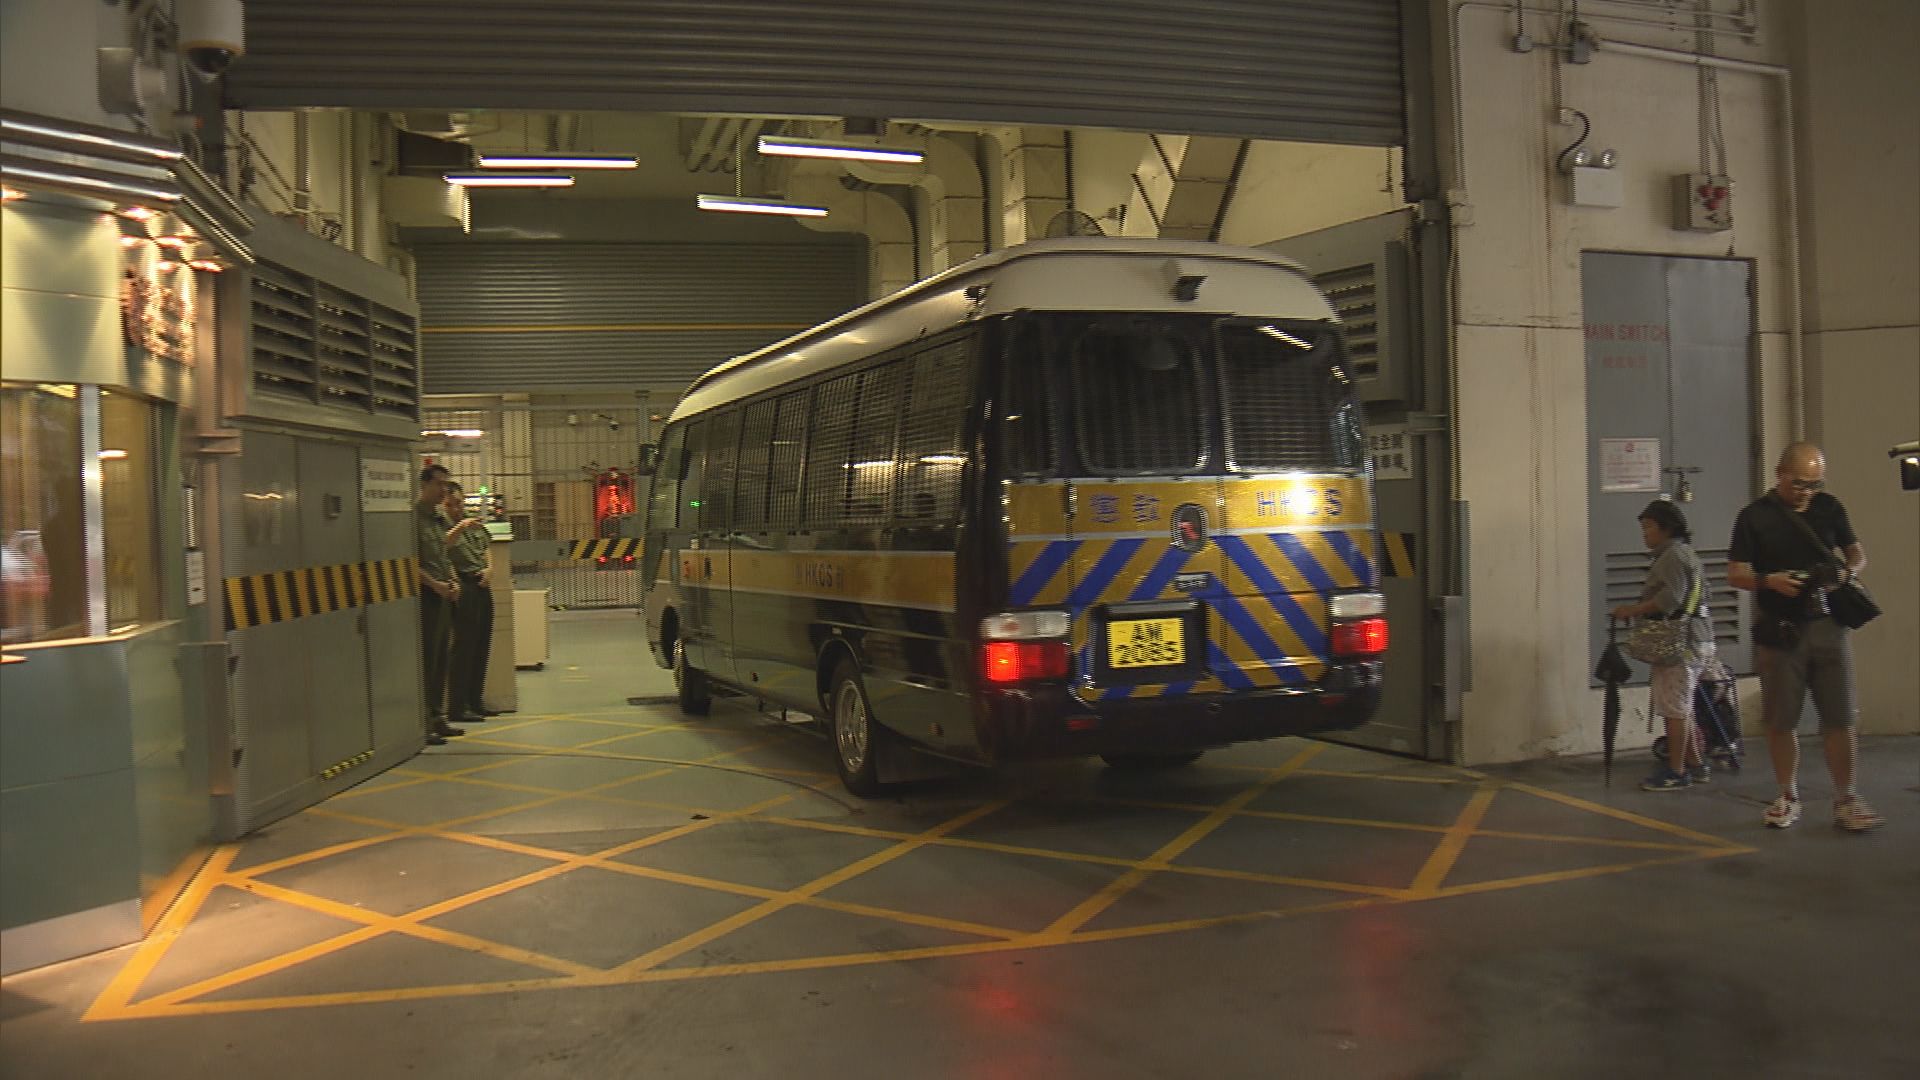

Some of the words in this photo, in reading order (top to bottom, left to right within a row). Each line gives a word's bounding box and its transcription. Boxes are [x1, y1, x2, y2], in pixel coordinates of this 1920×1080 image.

[1584, 323, 1615, 340] MAIN
[1617, 324, 1671, 342] SWITCH
[1130, 622, 1163, 643] AM
[1114, 641, 1181, 664] 2085
